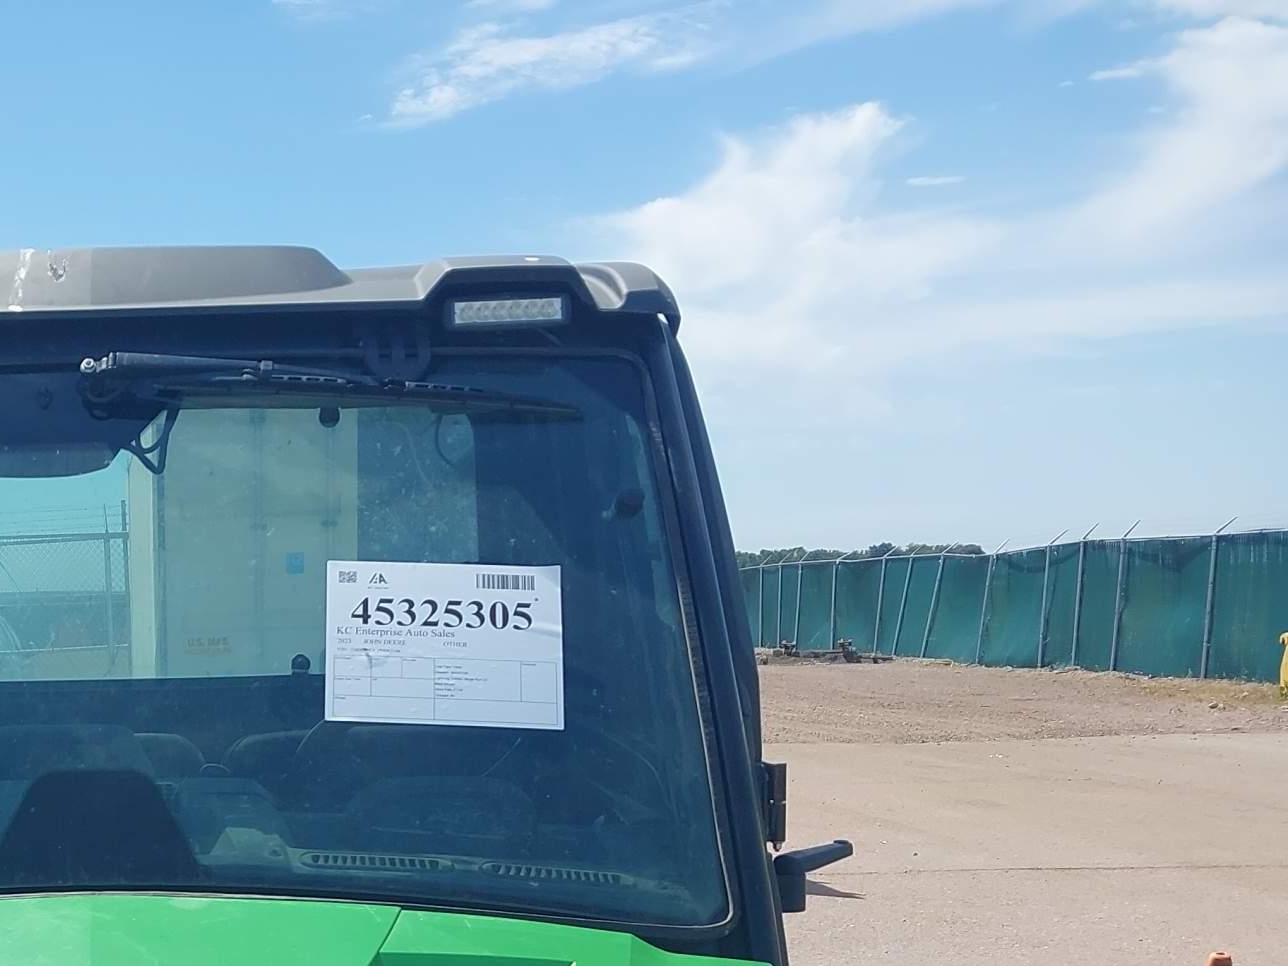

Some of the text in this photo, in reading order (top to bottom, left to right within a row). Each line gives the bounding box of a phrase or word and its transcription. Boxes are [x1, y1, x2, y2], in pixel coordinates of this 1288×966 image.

[350, 596, 533, 631] 45325305
[336, 626, 456, 638] KC Enterprise Auto Sales
